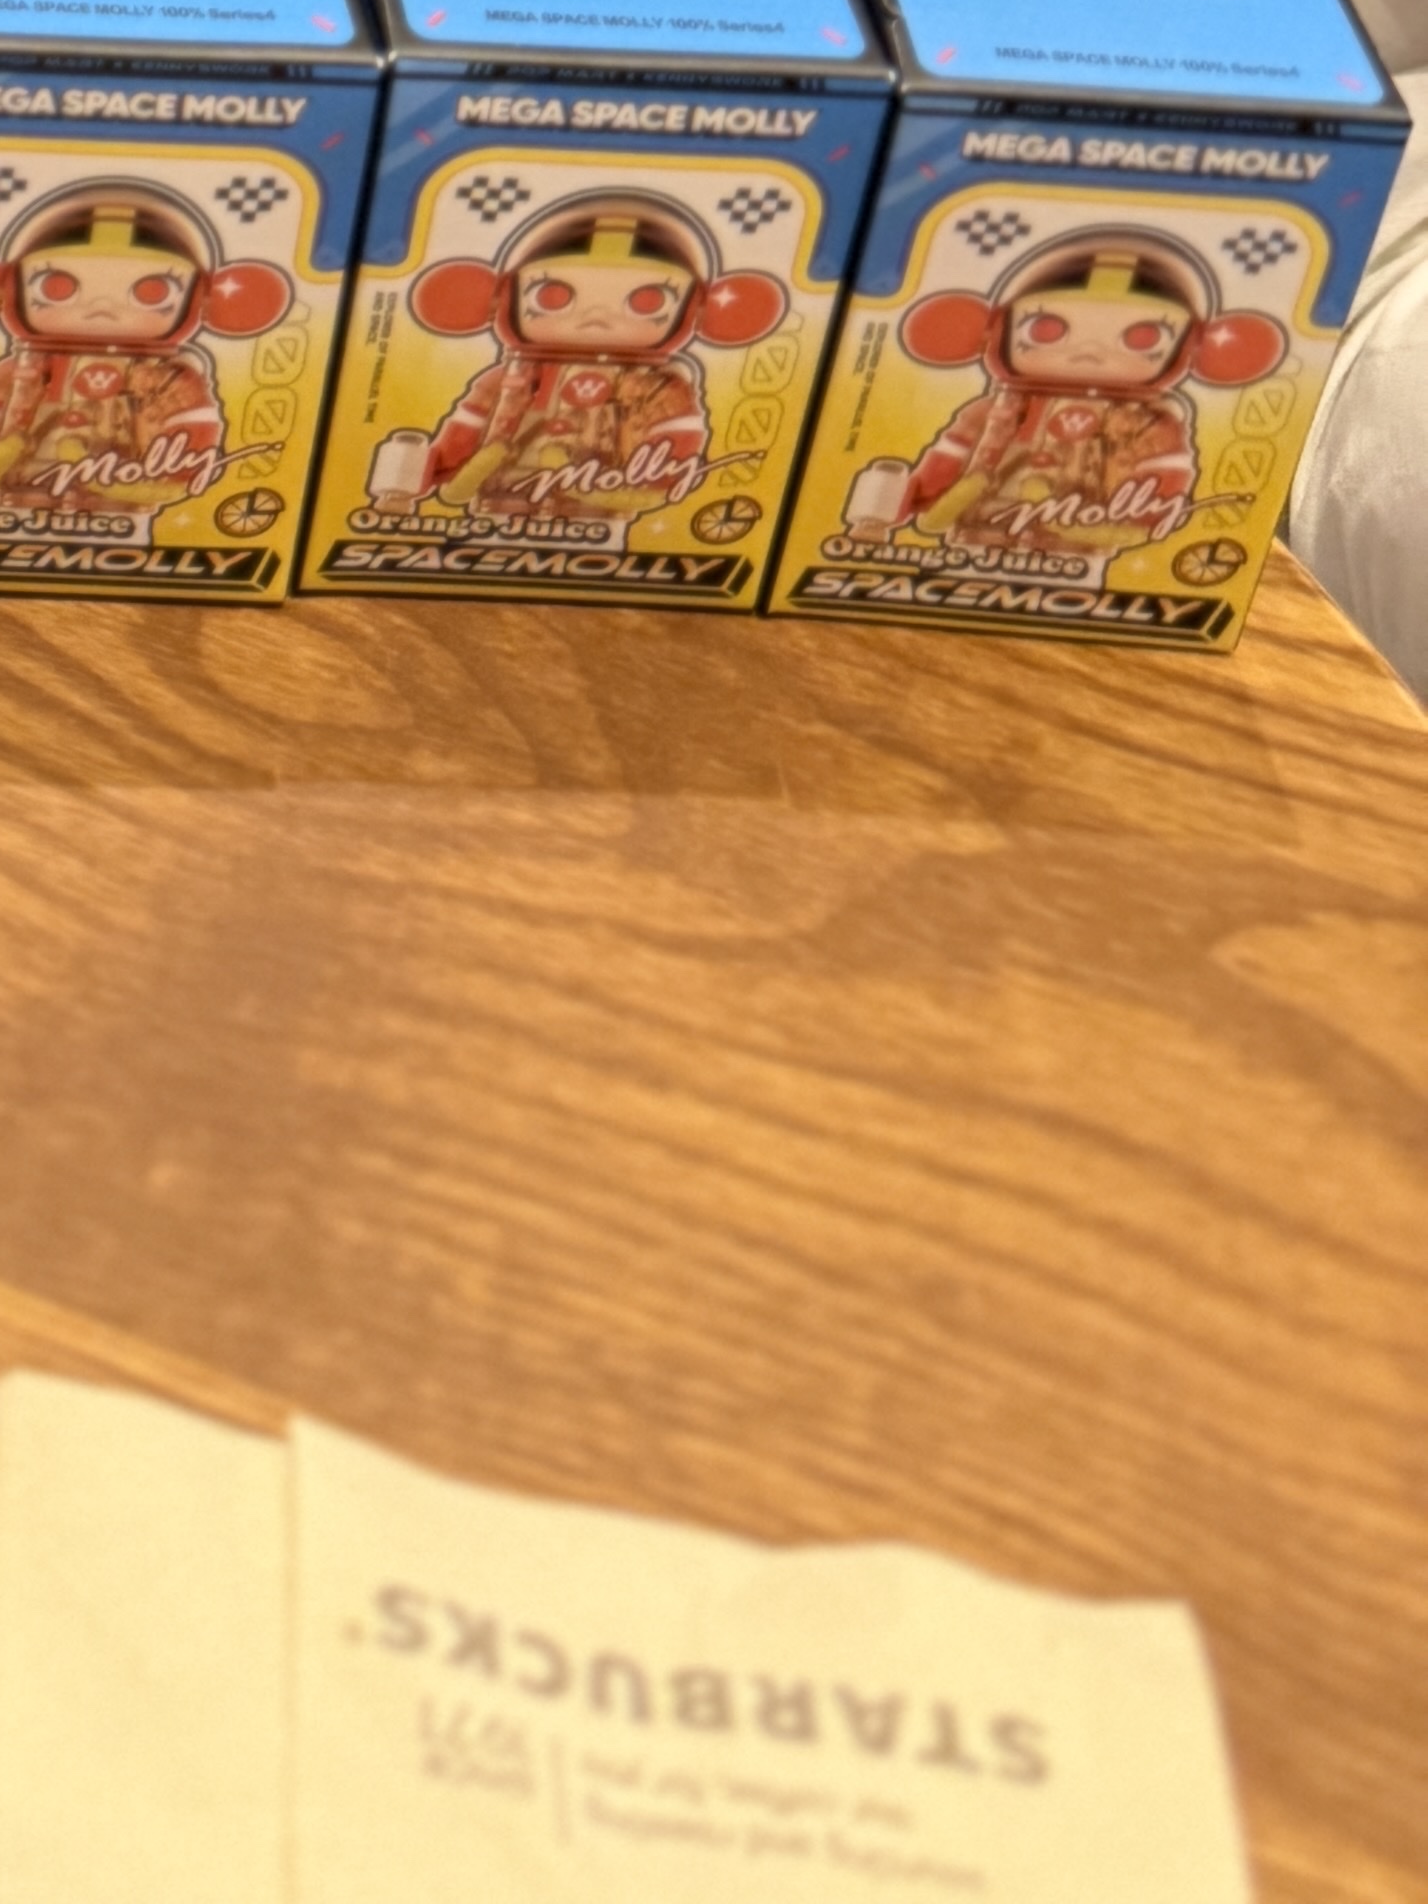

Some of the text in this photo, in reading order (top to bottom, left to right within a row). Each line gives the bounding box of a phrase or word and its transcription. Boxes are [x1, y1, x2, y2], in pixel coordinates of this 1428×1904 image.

[33, 0, 90, 13] SPACE
[94, 3, 155, 16] MOLLY
[62, 90, 176, 119] SPACE
[182, 95, 305, 124] MOLLY
[456, 96, 817, 135] MEGA SPACE MOLLY
[963, 131, 1330, 179] MEGA SPACE MOLLY
[34, 434, 283, 495] Molly
[514, 442, 766, 502] Molly
[23, 511, 134, 534] Juice
[348, 509, 609, 541] Orange Juice
[991, 480, 1257, 541] Molly
[821, 538, 1089, 577] Orange Juice
[370, 1584, 1051, 1790] STARBUCKS
